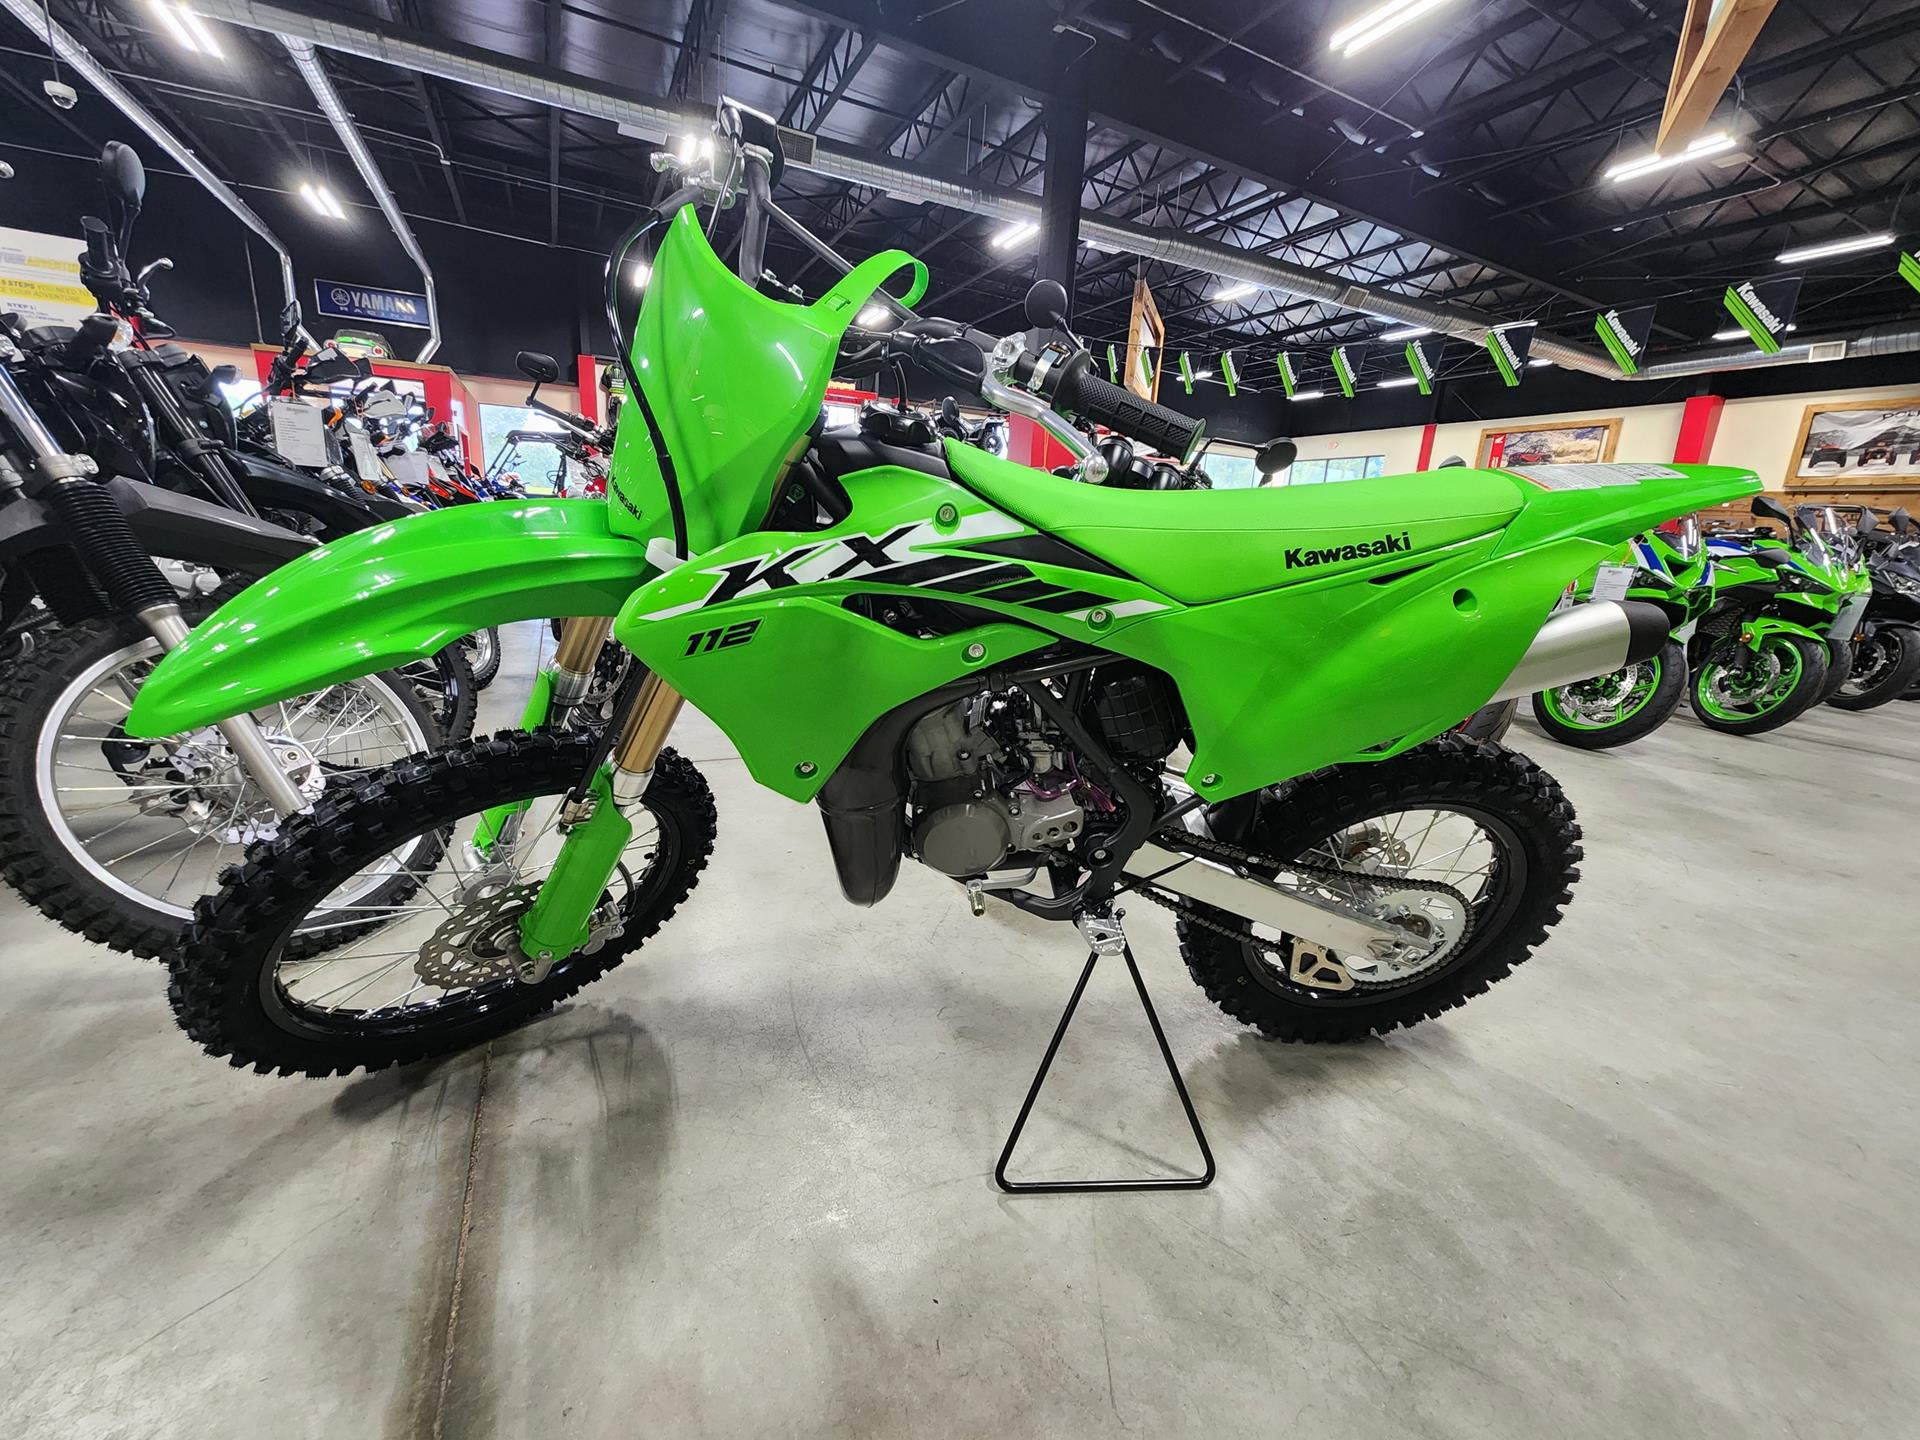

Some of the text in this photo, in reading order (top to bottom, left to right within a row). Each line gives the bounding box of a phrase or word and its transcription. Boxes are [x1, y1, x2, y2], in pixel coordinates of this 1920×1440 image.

[350, 291, 416, 314] YAMAHA
[1736, 282, 1784, 334] Kawasaki
[1494, 328, 1523, 371] Kawasaki
[1604, 309, 1641, 356] Kawasaki
[1338, 346, 1357, 383] Kawasaki
[1413, 340, 1435, 380] Kawasaki
[611, 474, 642, 520] Kawasaki
[701, 523, 924, 608] KX
[1284, 532, 1411, 569] Kawasaki
[684, 618, 763, 656] 112
